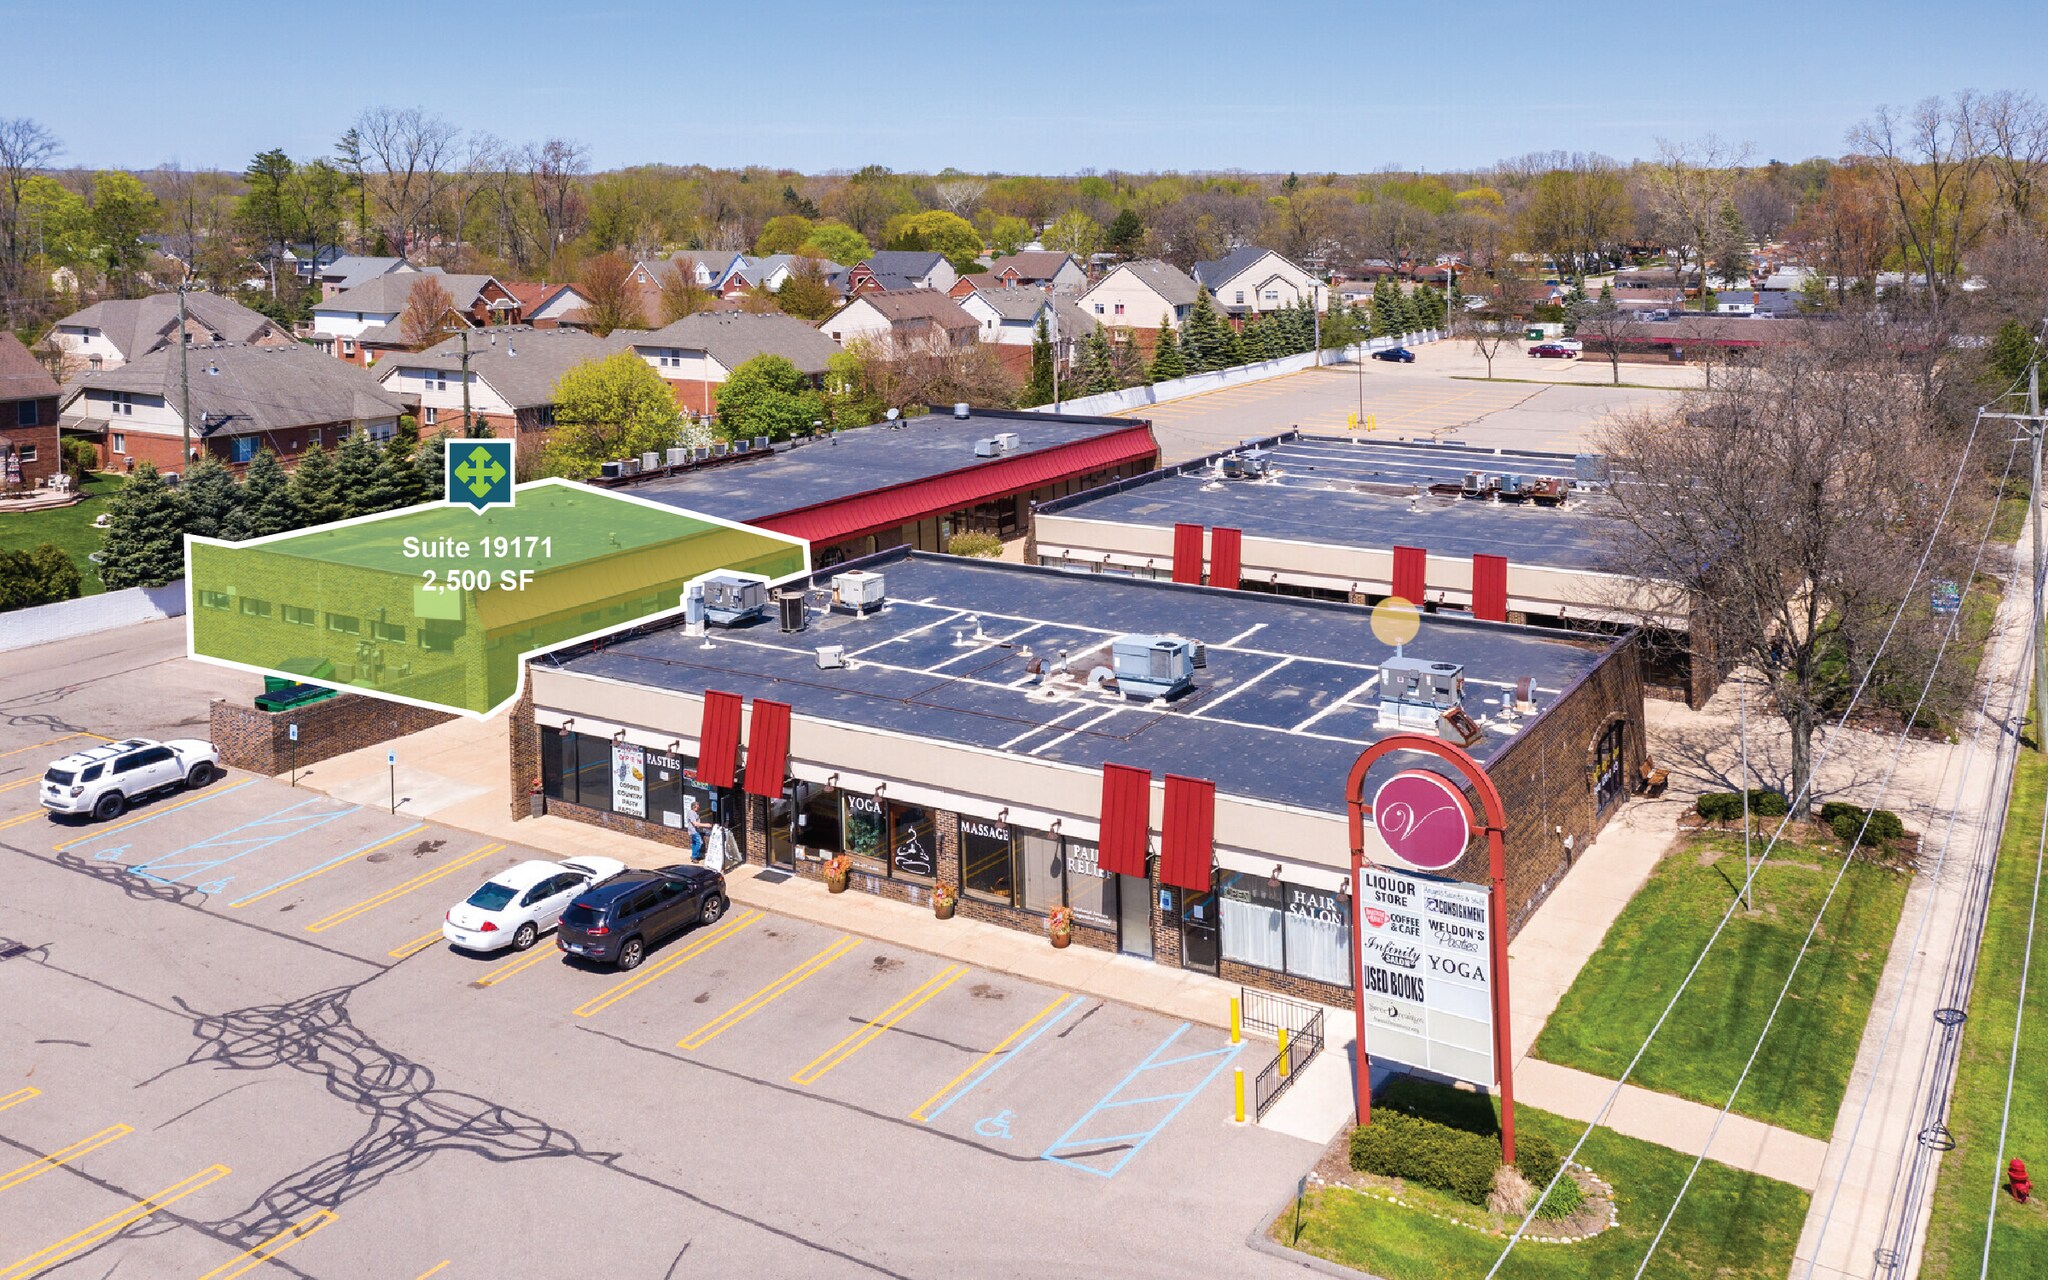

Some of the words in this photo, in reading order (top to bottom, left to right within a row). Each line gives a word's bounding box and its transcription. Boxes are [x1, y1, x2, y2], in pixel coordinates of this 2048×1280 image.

[646, 753, 680, 770] PASTIES
[847, 795, 882, 814] YOGA
[961, 820, 1009, 841] MASSAGE
[1073, 844, 1099, 862] PAI
[1366, 873, 1415, 896] LIQUOR
[1294, 890, 1337, 912] HAIR
[1375, 890, 1407, 907] STORE
[1289, 903, 1342, 925] SALON
[1390, 913, 1420, 927] COFFEE
[1439, 900, 1485, 923] CONSIGNMENT
[1390, 923, 1398, 932] &
[1399, 924, 1420, 937] CAFE
[1428, 919, 1485, 941] WELDON'S
[1364, 937, 1420, 963] Infinity
[1434, 931, 1479, 952] Pasties
[1428, 955, 1486, 982] YOGA
[1364, 965, 1388, 994] USED
[1390, 971, 1424, 1003] BOOKS
